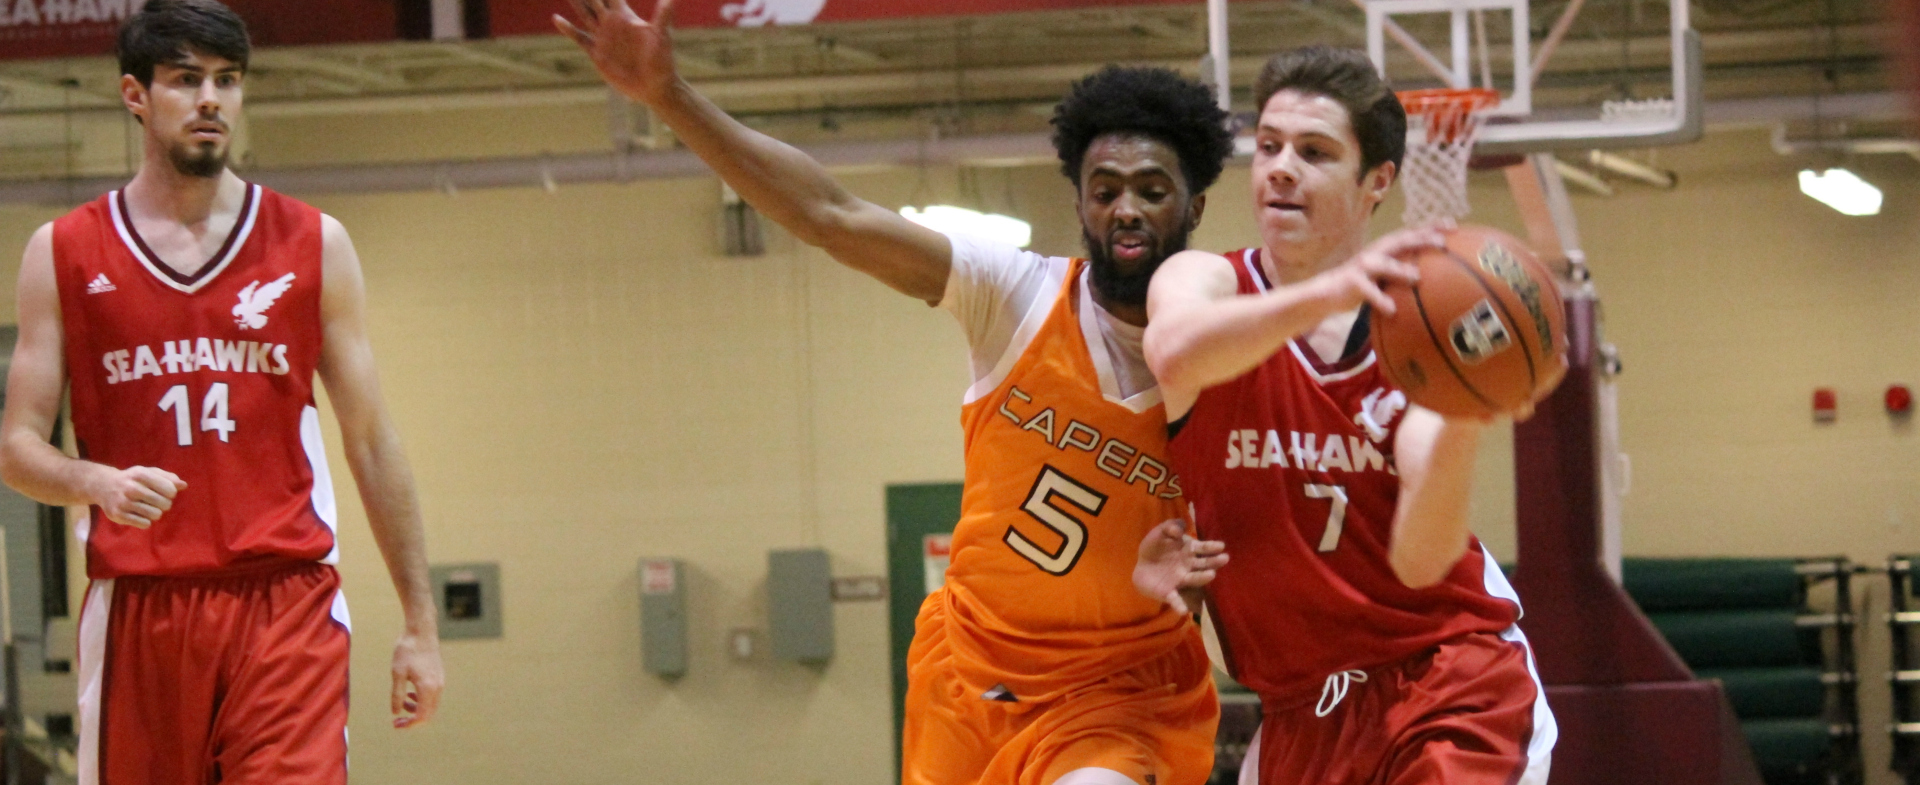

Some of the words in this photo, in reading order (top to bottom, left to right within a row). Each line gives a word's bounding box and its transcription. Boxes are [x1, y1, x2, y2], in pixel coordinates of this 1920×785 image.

[157, 381, 236, 446] 14
[999, 385, 1183, 499] CAPERS
[1002, 463, 1109, 576] 5
[1303, 483, 1348, 552] 7
